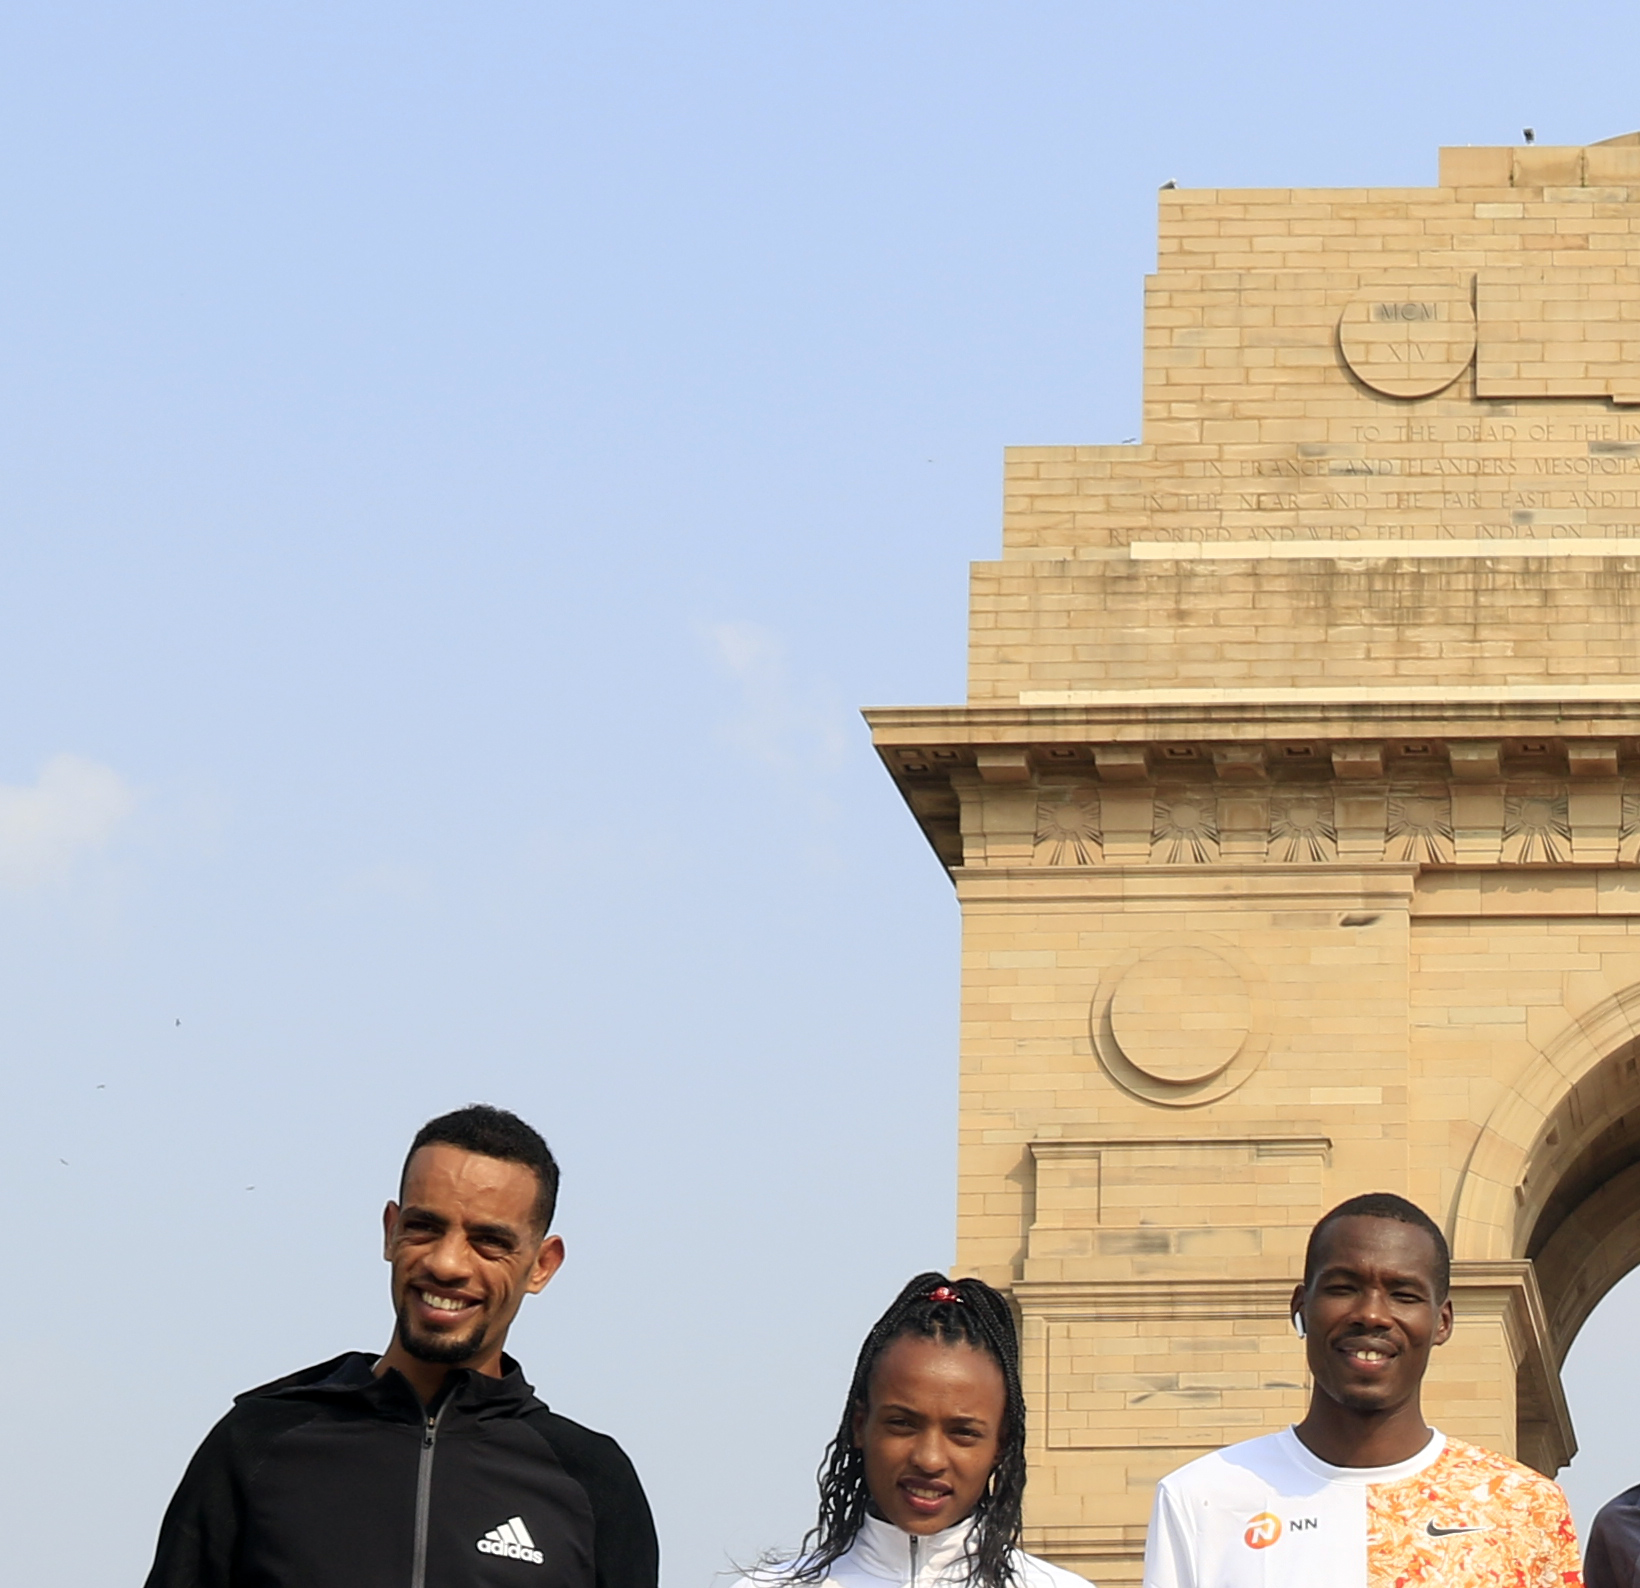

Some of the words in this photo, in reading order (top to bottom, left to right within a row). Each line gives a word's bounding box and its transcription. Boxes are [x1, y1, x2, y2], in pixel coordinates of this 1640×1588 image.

[1381, 303, 1438, 321] MCM
[1387, 343, 1431, 362] XIV
[1351, 426, 1380, 442] TO
[1394, 426, 1436, 442] THE
[1457, 426, 1516, 441] DEAD
[1528, 425, 1553, 441] OF
[1570, 425, 1611, 441] THE
[1203, 460, 1222, 476] IN
[1240, 460, 1327, 475] FRANCE
[1346, 460, 1393, 475] AND
[1408, 459, 1517, 475] FLANDERS
[1143, 494, 1163, 510] IN
[1182, 494, 1221, 510] THE
[1240, 493, 1299, 509] NEAR
[1321, 493, 1369, 509] AND
[1385, 493, 1422, 509] THE
[1443, 493, 1481, 509] FAR
[1501, 492, 1549, 508] EAST
[1569, 492, 1616, 508] AND
[1248, 527, 1295, 541] AND
[1307, 526, 1361, 541] WHO
[1434, 526, 1456, 540] IN
[1475, 526, 1536, 540] INDIA
[1551, 525, 1582, 540] ON
[1601, 525, 1640, 540] THE
[1290, 1518, 1317, 1532] NN
[476, 1539, 544, 1565] adidas
